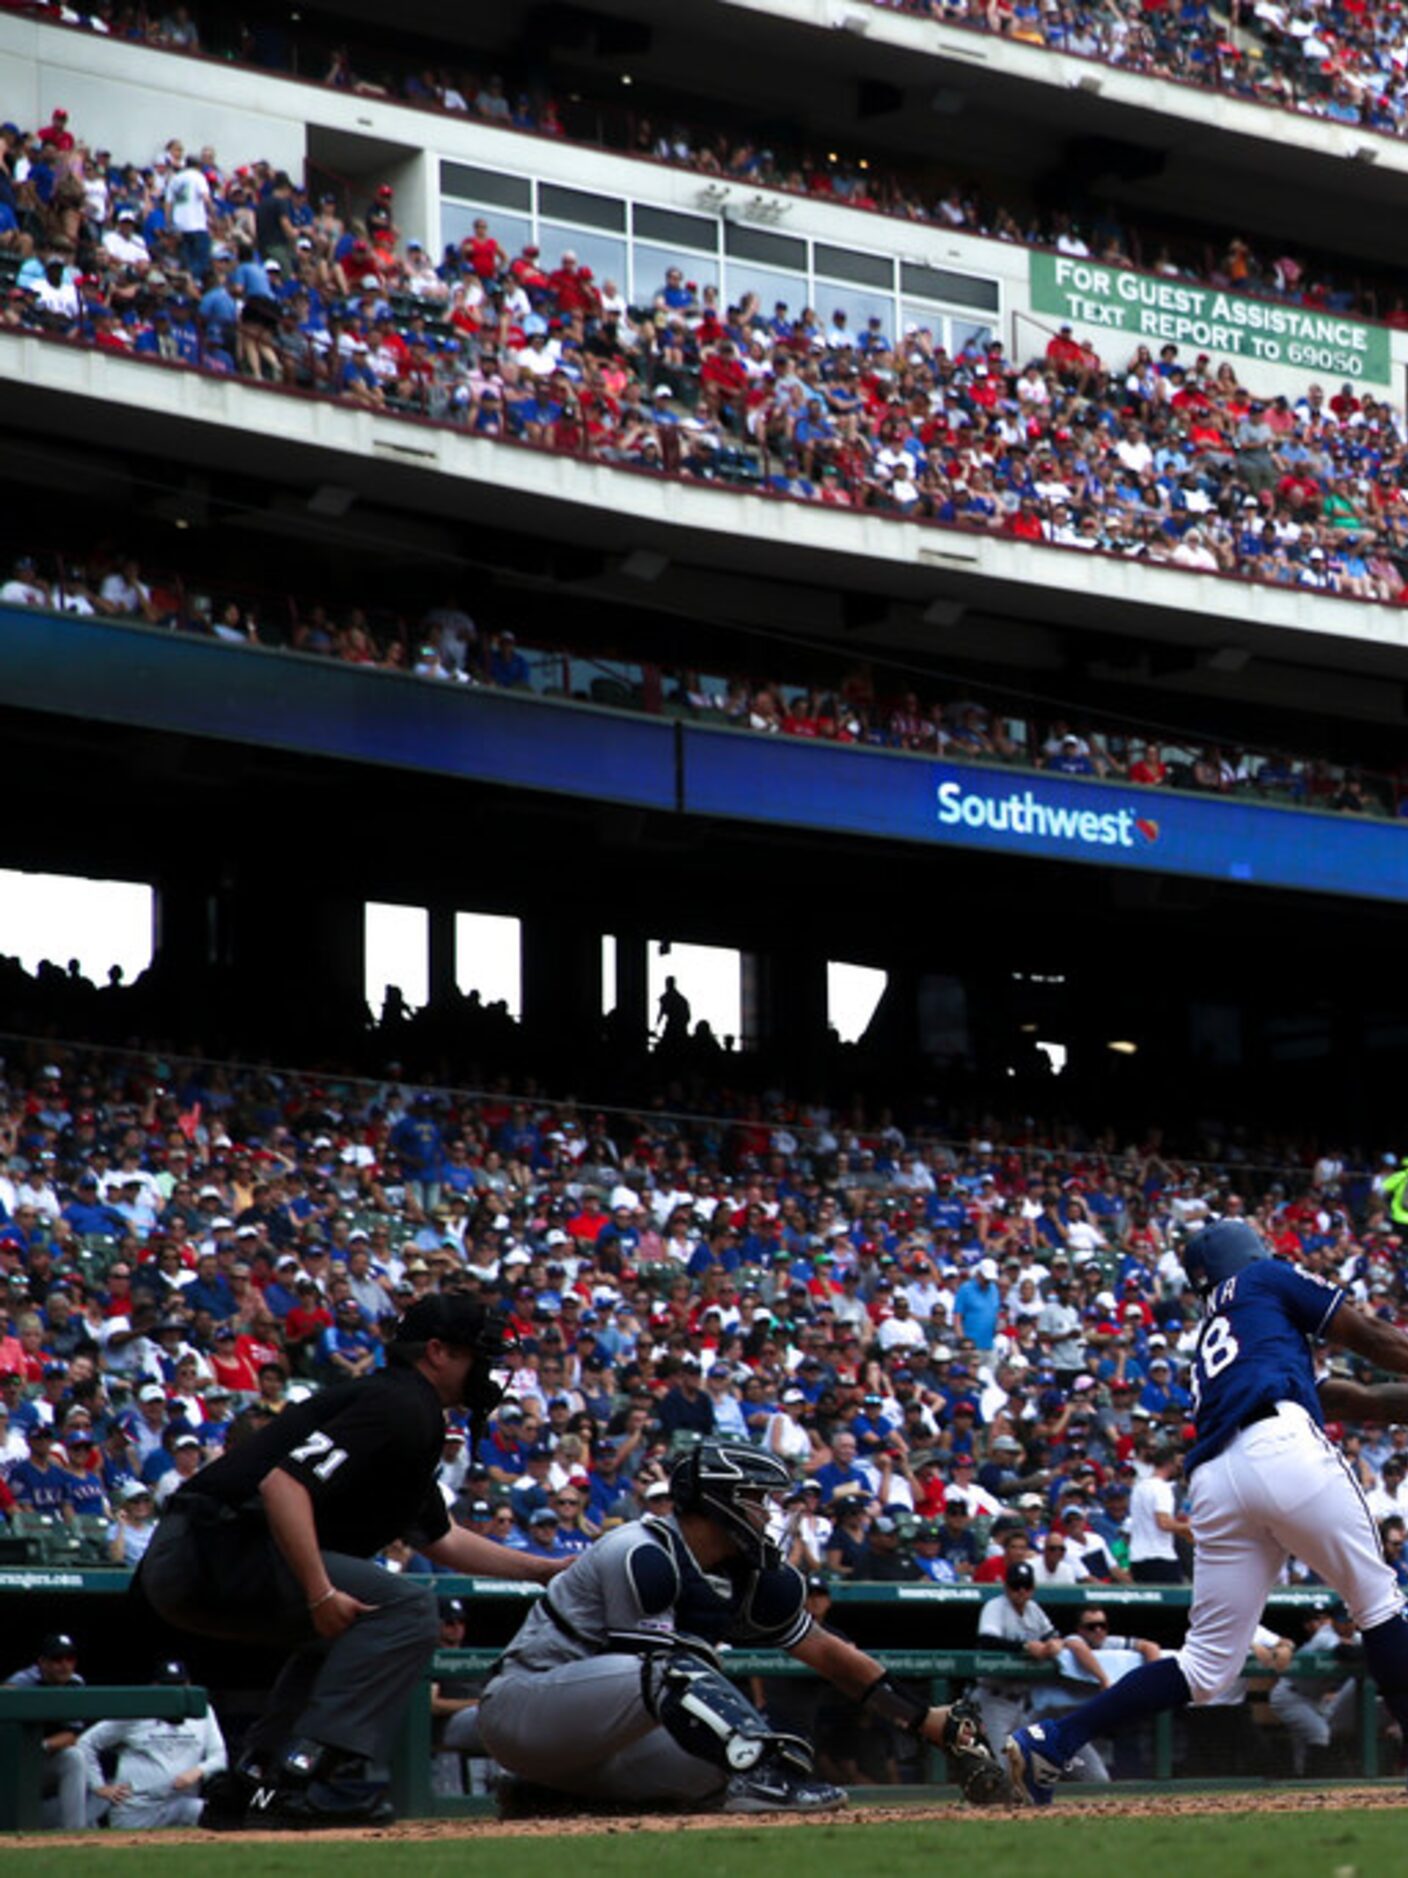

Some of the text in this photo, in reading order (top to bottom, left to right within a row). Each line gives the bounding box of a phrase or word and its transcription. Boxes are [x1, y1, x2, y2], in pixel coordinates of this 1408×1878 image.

[1055, 258, 1368, 351] FOR GUEST ASSISTANCE
[1065, 293, 1363, 377] TEXT REPORT TO 69050
[937, 781, 1135, 847] Southwest
[289, 1429, 349, 1482] 71
